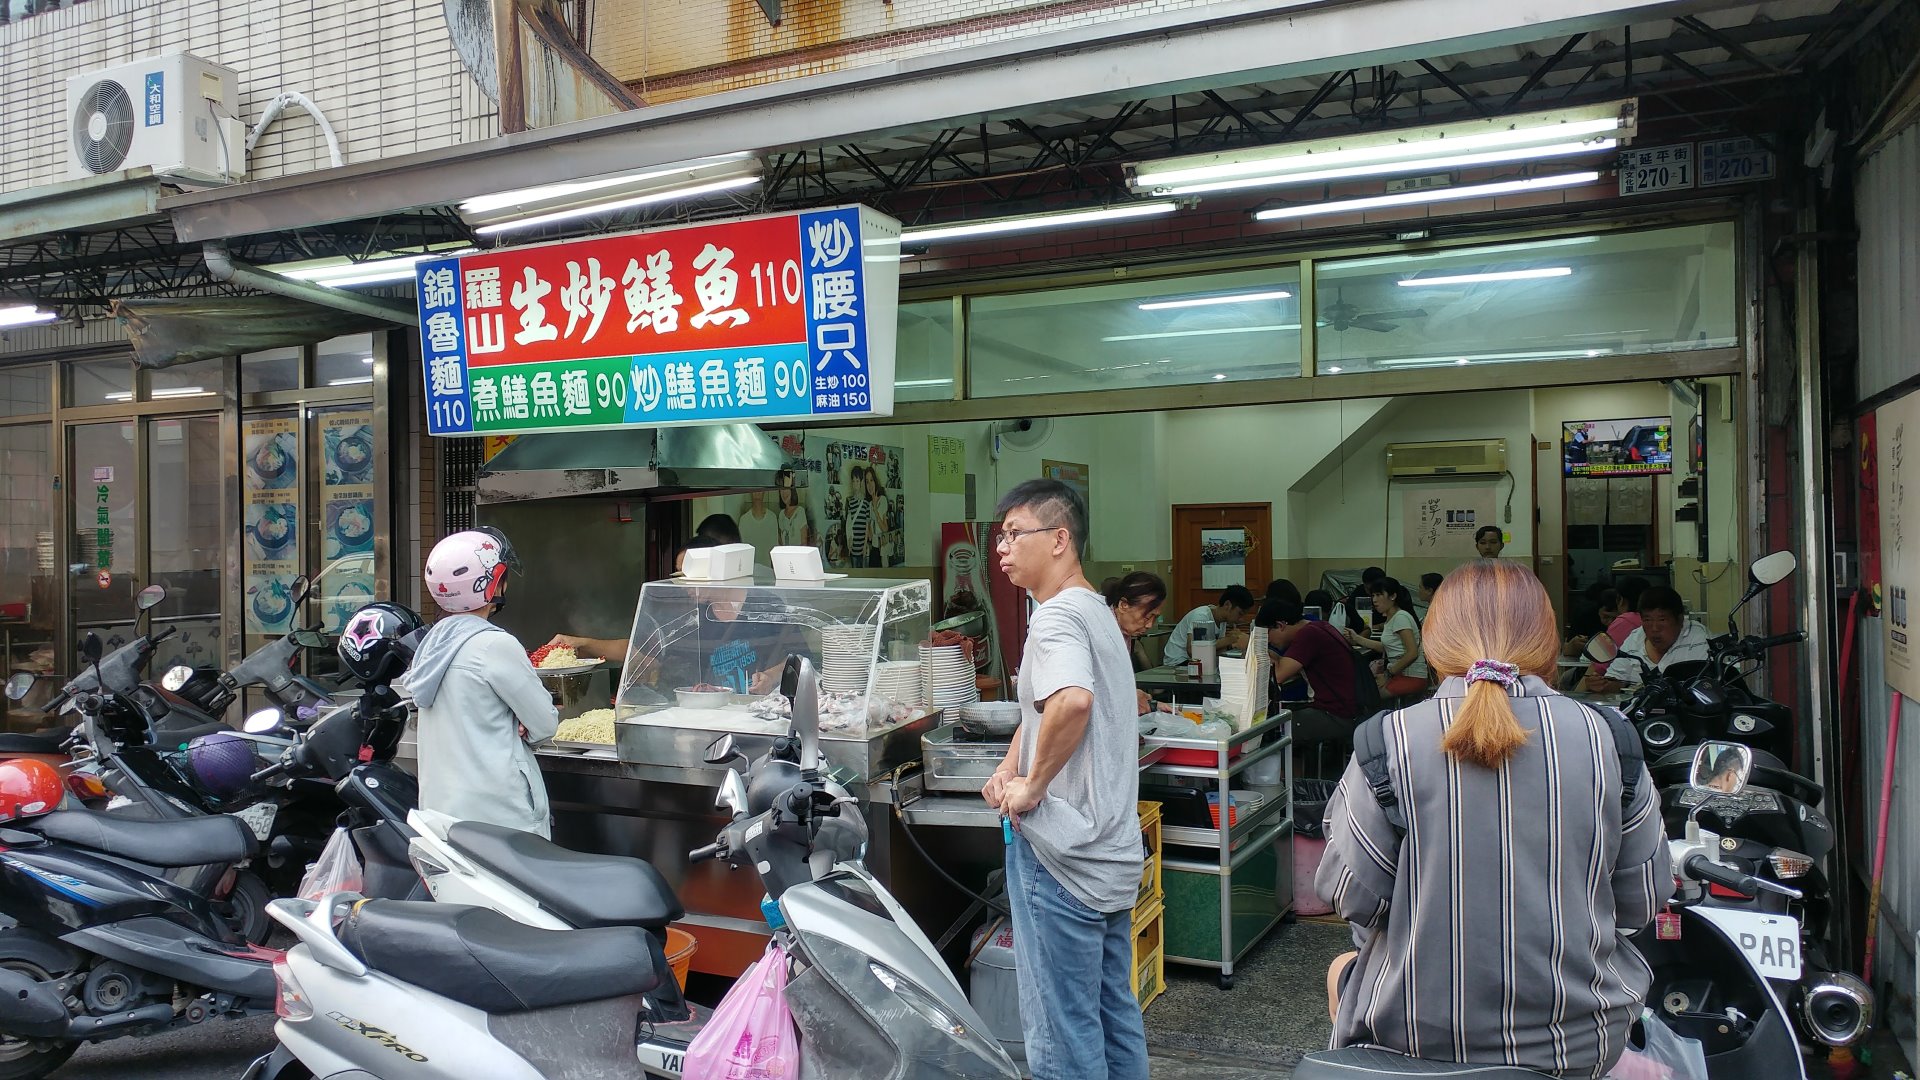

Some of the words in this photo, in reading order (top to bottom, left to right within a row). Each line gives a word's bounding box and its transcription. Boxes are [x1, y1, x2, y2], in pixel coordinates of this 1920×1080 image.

[149, 83, 161, 125] 大和空調
[1639, 148, 1687, 165] 延平街
[1719, 155, 1769, 179] 270-1
[464, 267, 505, 355] 羅山
[509, 243, 750, 346] 生炒鱔魚
[750, 258, 801, 309] 110
[807, 217, 862, 371] 炒腰只
[424, 267, 465, 397] 錦魯麵
[472, 369, 591, 423] 煮鱔魚麵
[596, 371, 627, 410] 90
[633, 356, 768, 414] 炒鱔魚麵
[774, 359, 808, 400] 90
[815, 374, 840, 390] 生炒
[841, 373, 867, 388] 100
[815, 393, 840, 408] 麻油
[842, 391, 868, 407] 150
[432, 399, 466, 429] 110
[1739, 932, 1796, 968] PAR
